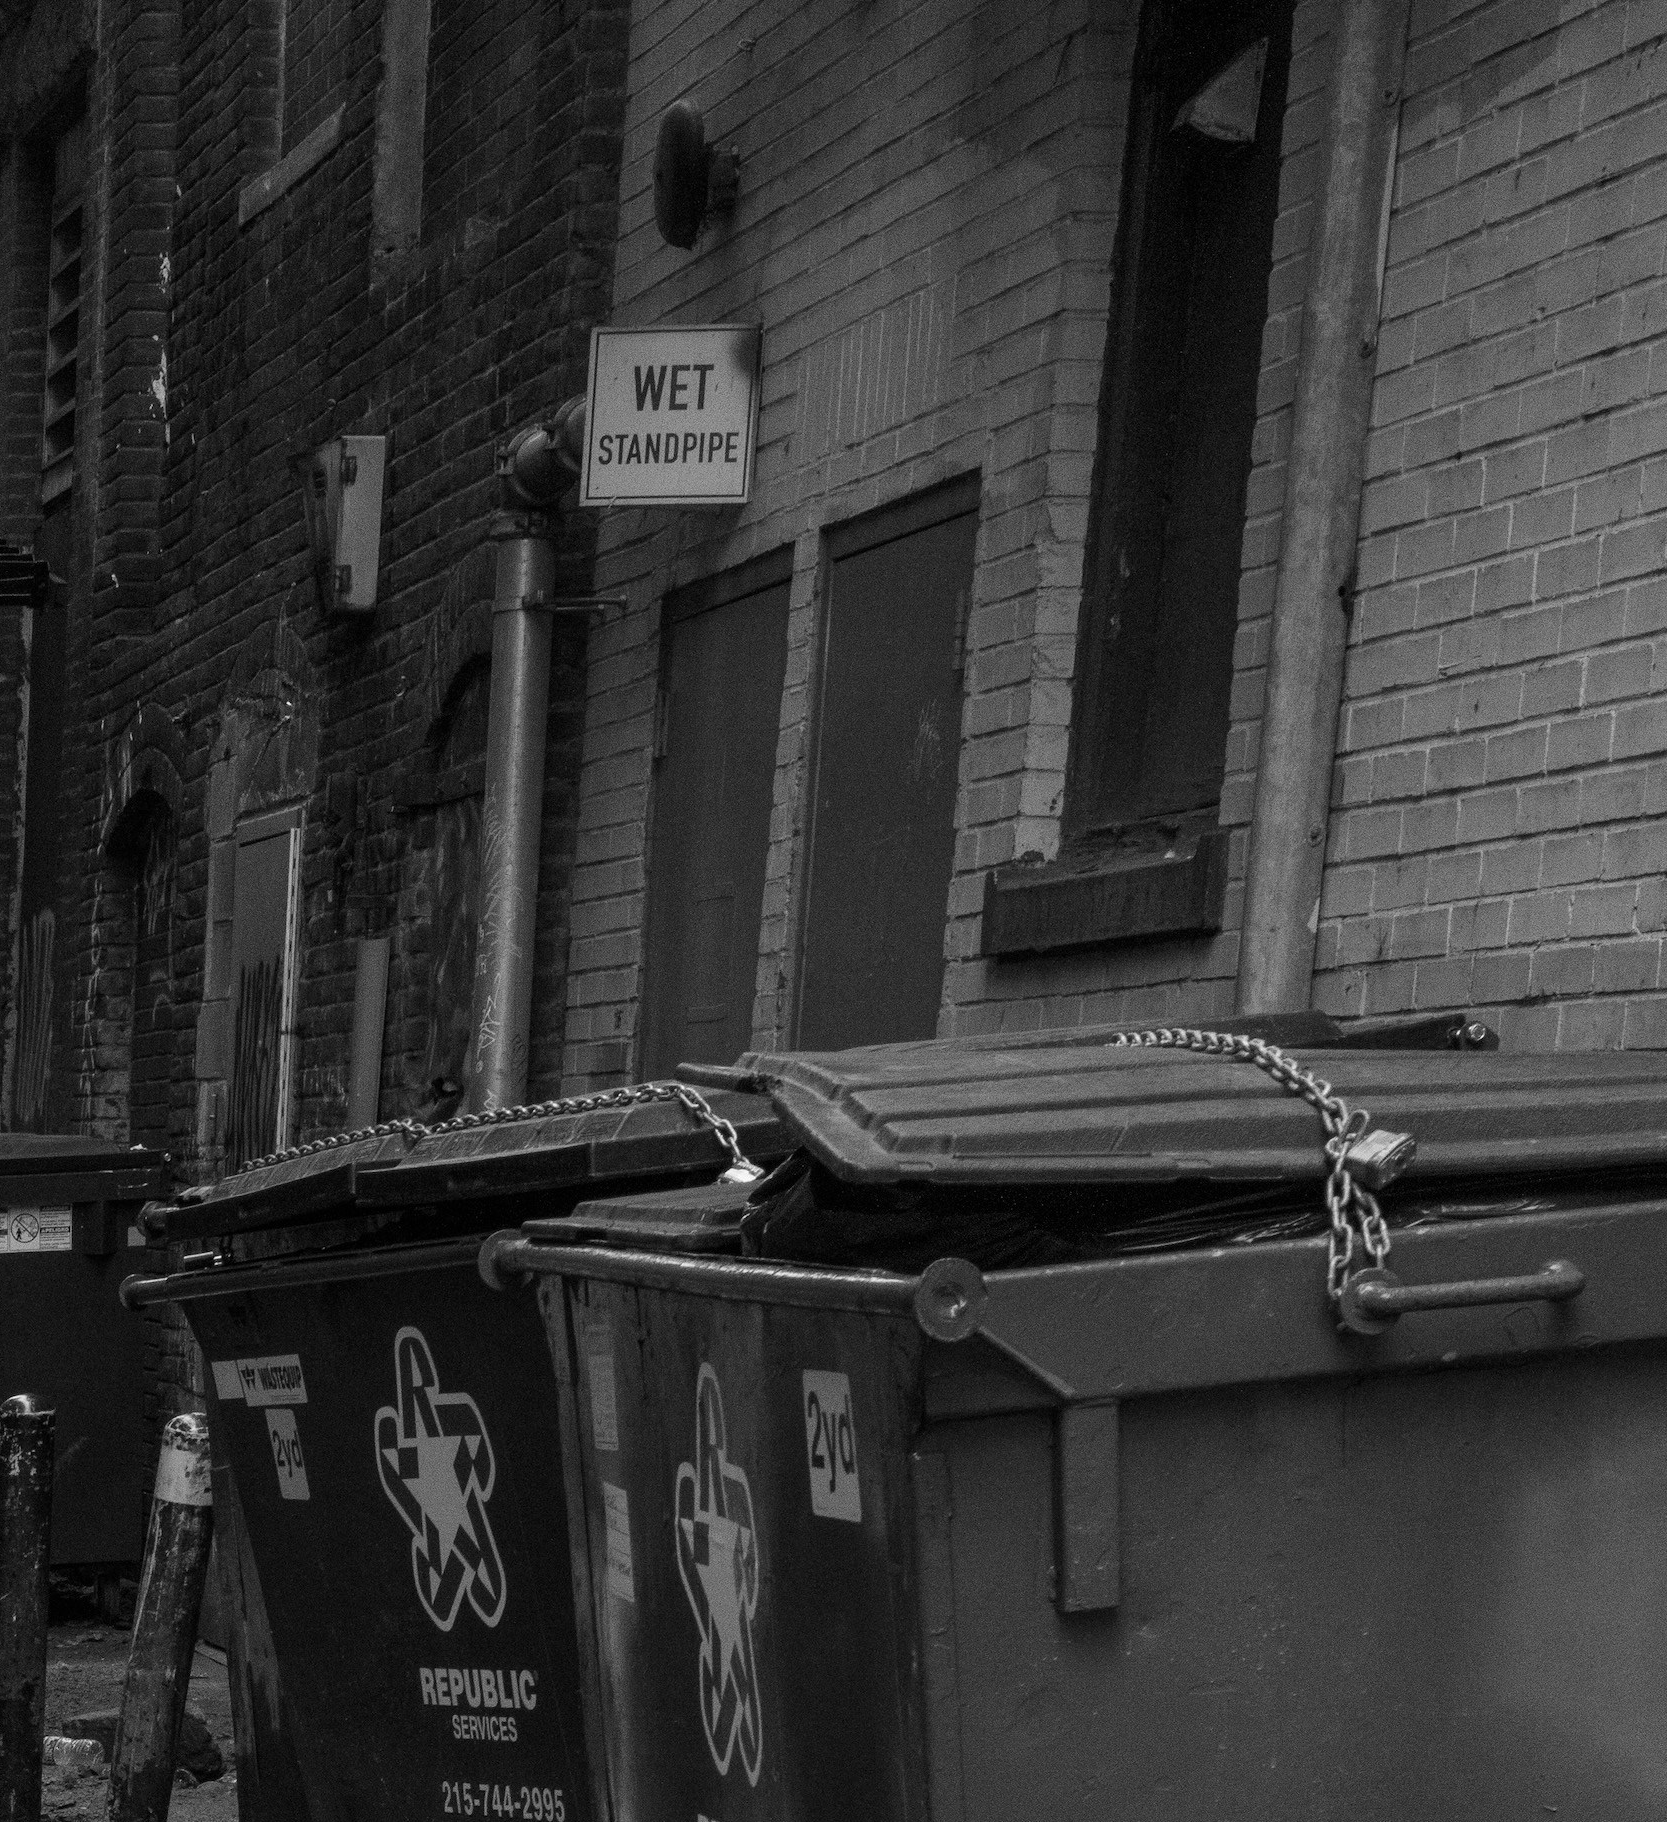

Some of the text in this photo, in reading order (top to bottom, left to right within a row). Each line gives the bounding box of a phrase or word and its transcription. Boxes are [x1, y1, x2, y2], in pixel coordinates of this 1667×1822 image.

[634, 364, 715, 412] WET
[598, 432, 740, 465] STANDPIPE
[272, 1429, 303, 1478] 2yd
[808, 1390, 855, 1494] 2yd
[419, 1667, 537, 1710] REPUBLIC
[452, 1714, 518, 1742] SERVICES
[442, 1780, 566, 1822] 215-744-2995
